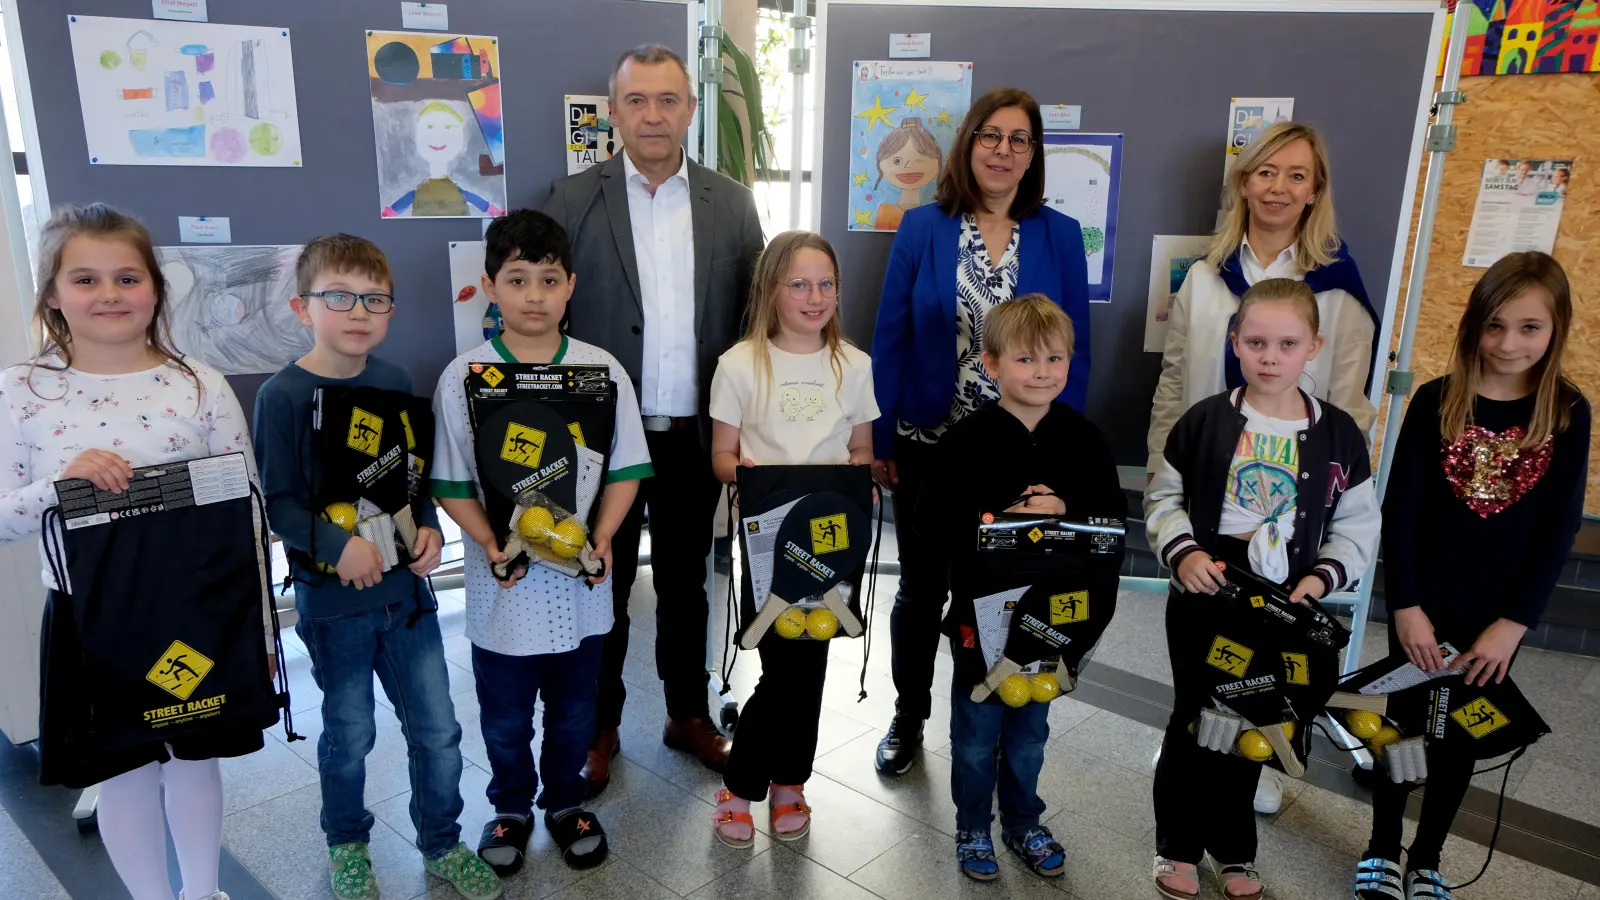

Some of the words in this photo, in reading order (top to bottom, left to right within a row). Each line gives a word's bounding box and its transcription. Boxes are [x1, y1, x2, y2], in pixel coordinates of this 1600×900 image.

[515, 373, 539, 381] STREET
[540, 373, 563, 381] RACKET
[516, 383, 563, 391] STREETRACKET.COM
[356, 461, 380, 483] STREET
[379, 444, 402, 466] RACKET
[512, 472, 541, 493] STREET
[541, 456, 569, 477] RACKET
[785, 541, 811, 565] STREET
[809, 558, 836, 579] RACKET
[1022, 613, 1048, 632] STREET
[1045, 627, 1072, 645] RACKET
[1215, 681, 1244, 693] STREET
[1245, 674, 1276, 687] RACKET
[143, 704, 184, 721] STREET
[187, 694, 226, 712] RACKET
[1438, 686, 1450, 713] STREET
[1435, 713, 1447, 739] RACKET
